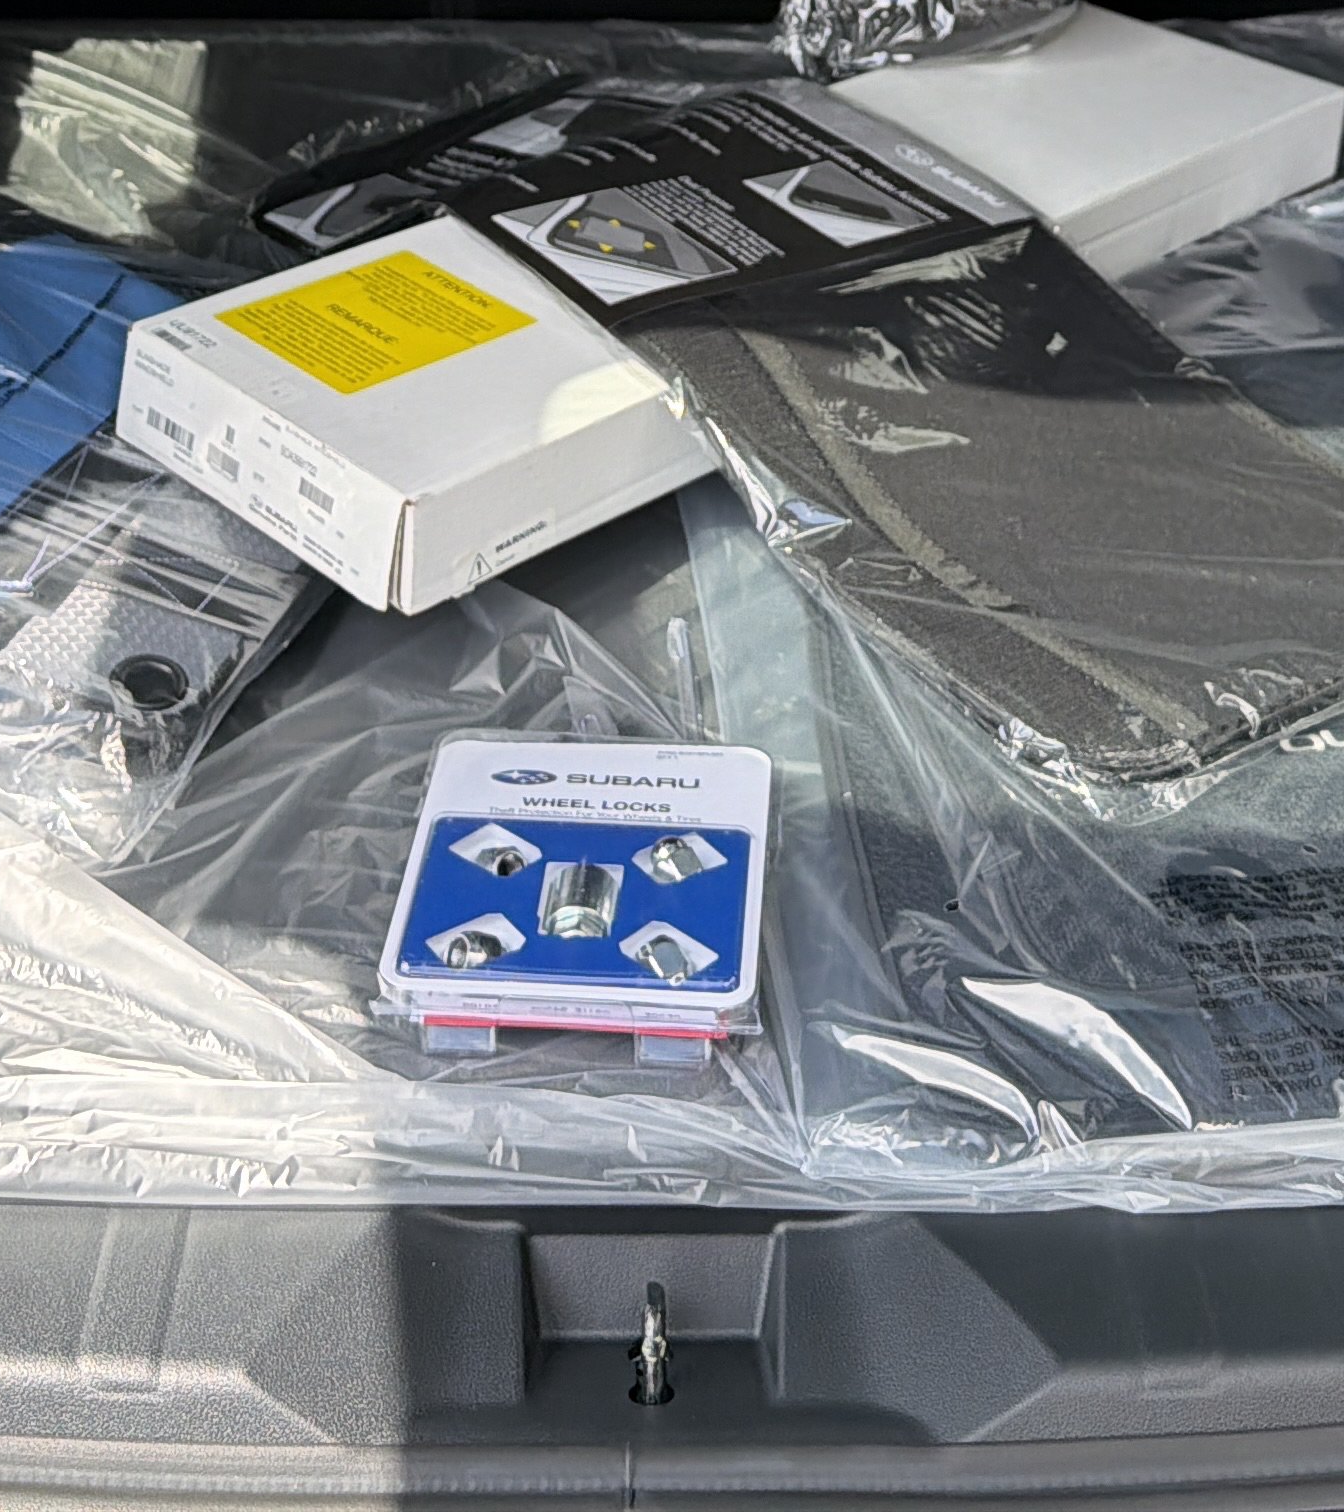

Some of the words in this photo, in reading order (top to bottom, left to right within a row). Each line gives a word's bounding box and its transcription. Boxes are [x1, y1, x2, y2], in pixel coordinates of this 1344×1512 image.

[566, 773, 701, 790] SUBARU
[521, 795, 596, 810] WHEEL
[600, 799, 672, 814] LOCKS
